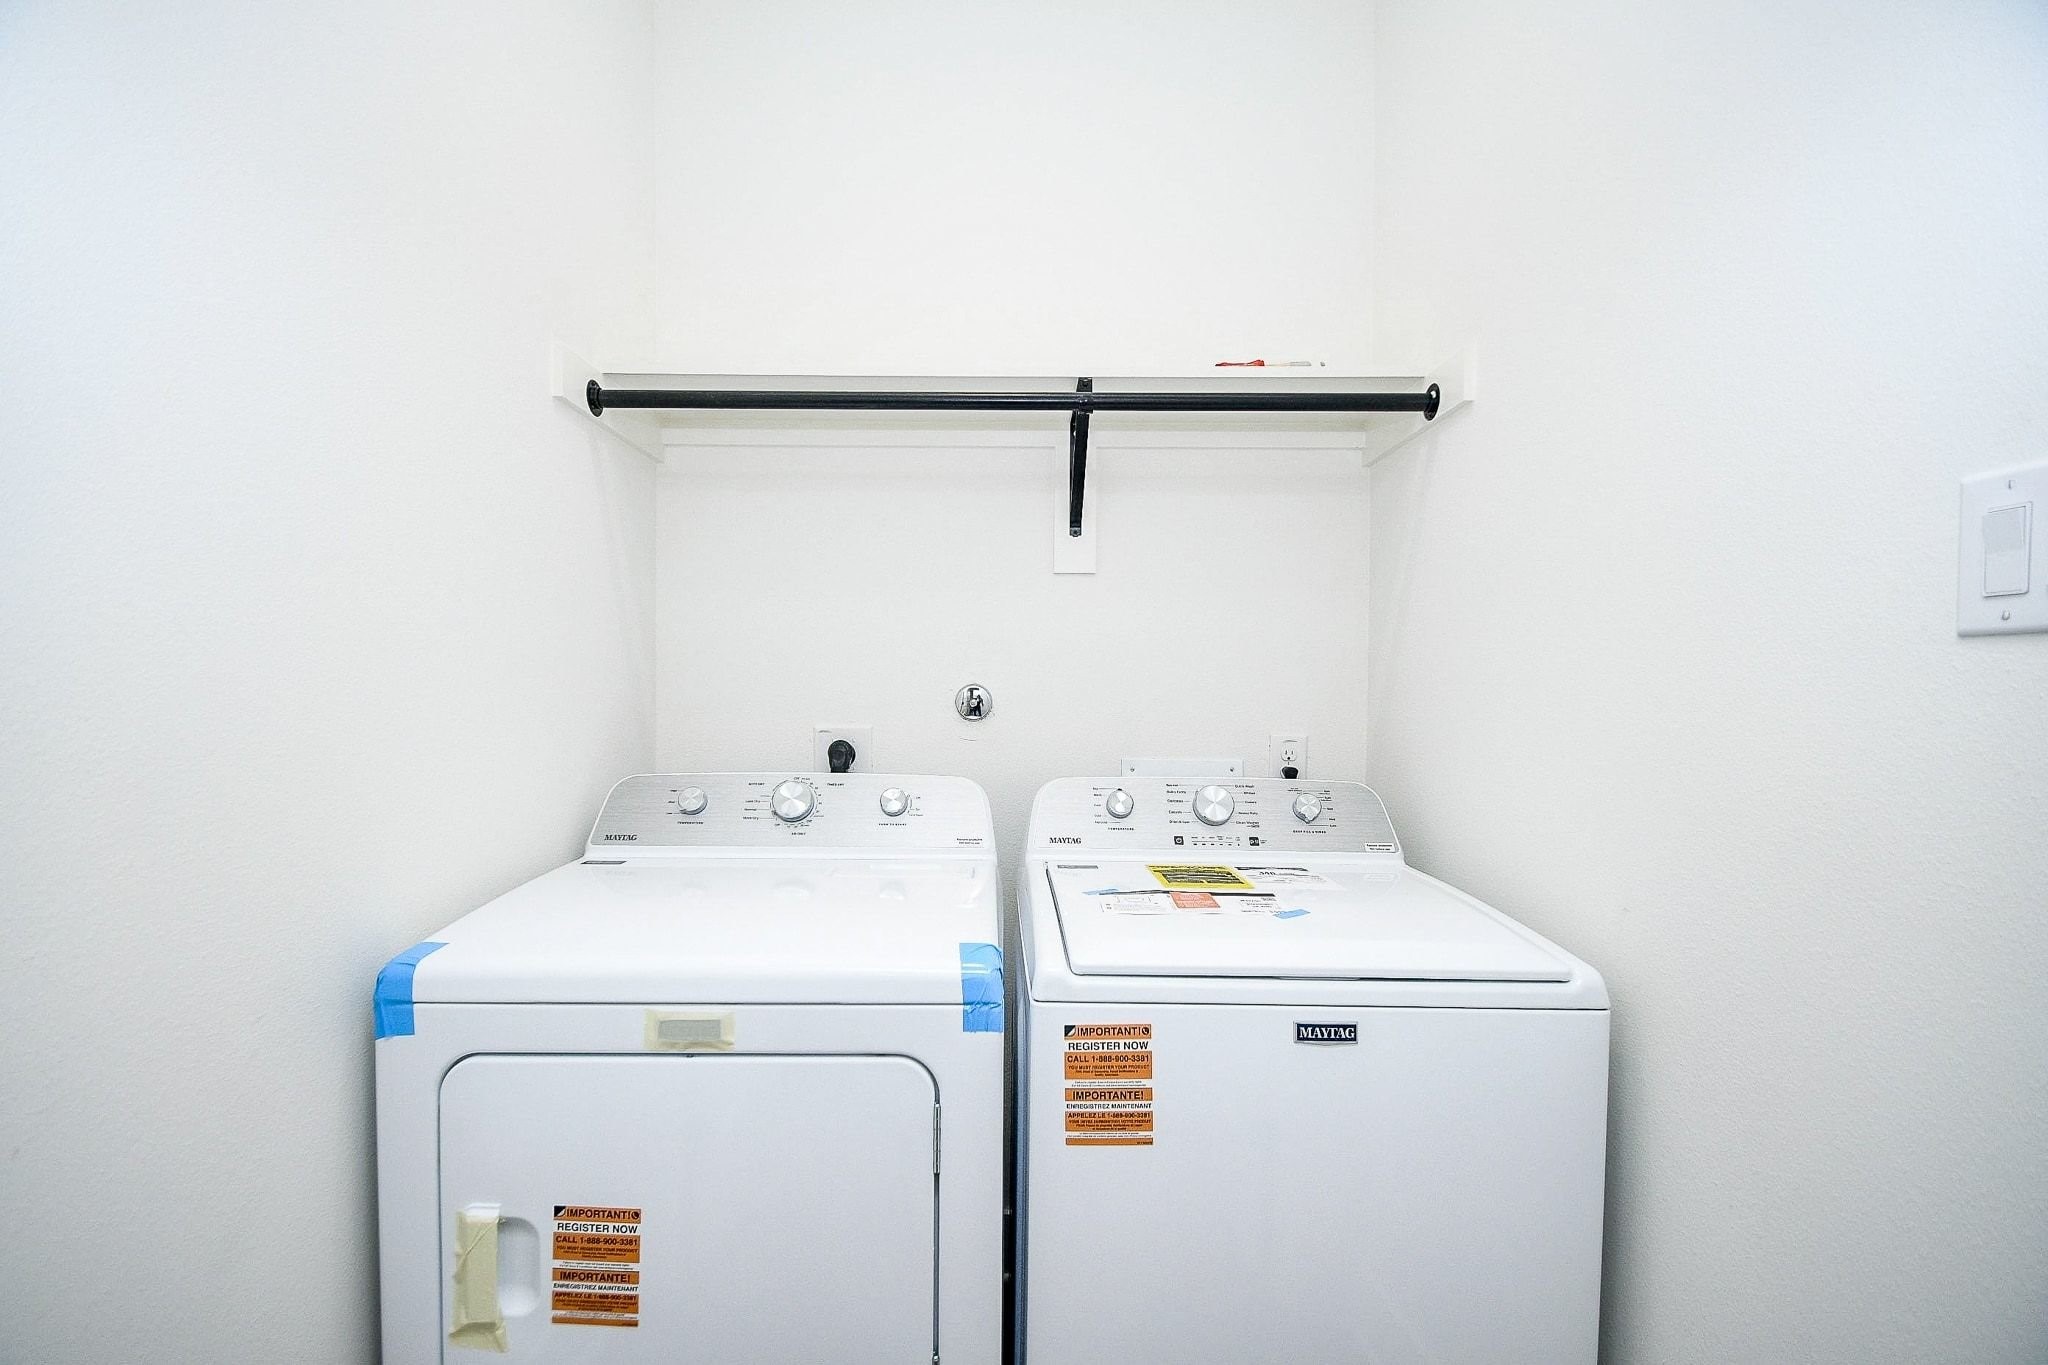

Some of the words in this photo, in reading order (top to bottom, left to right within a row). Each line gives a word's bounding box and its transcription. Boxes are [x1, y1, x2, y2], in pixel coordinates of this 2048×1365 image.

[1299, 1026, 1355, 1039] MAYTAG
[1068, 1041, 1120, 1051] REGISTER
[1123, 1041, 1149, 1050] NOW
[1067, 1055, 1089, 1063] CALL
[1091, 1054, 1149, 1063] 1-888-900-3381
[1073, 1091, 1144, 1100] IMPORTANTE!
[566, 1208, 631, 1220] IMPORTANT!
[557, 1222, 610, 1233] REGISTER
[612, 1224, 638, 1234] NOW
[555, 1235, 577, 1244] CALL
[580, 1236, 637, 1246] 1-888-900-3381
[560, 1271, 631, 1283] IMPORTANTE!
